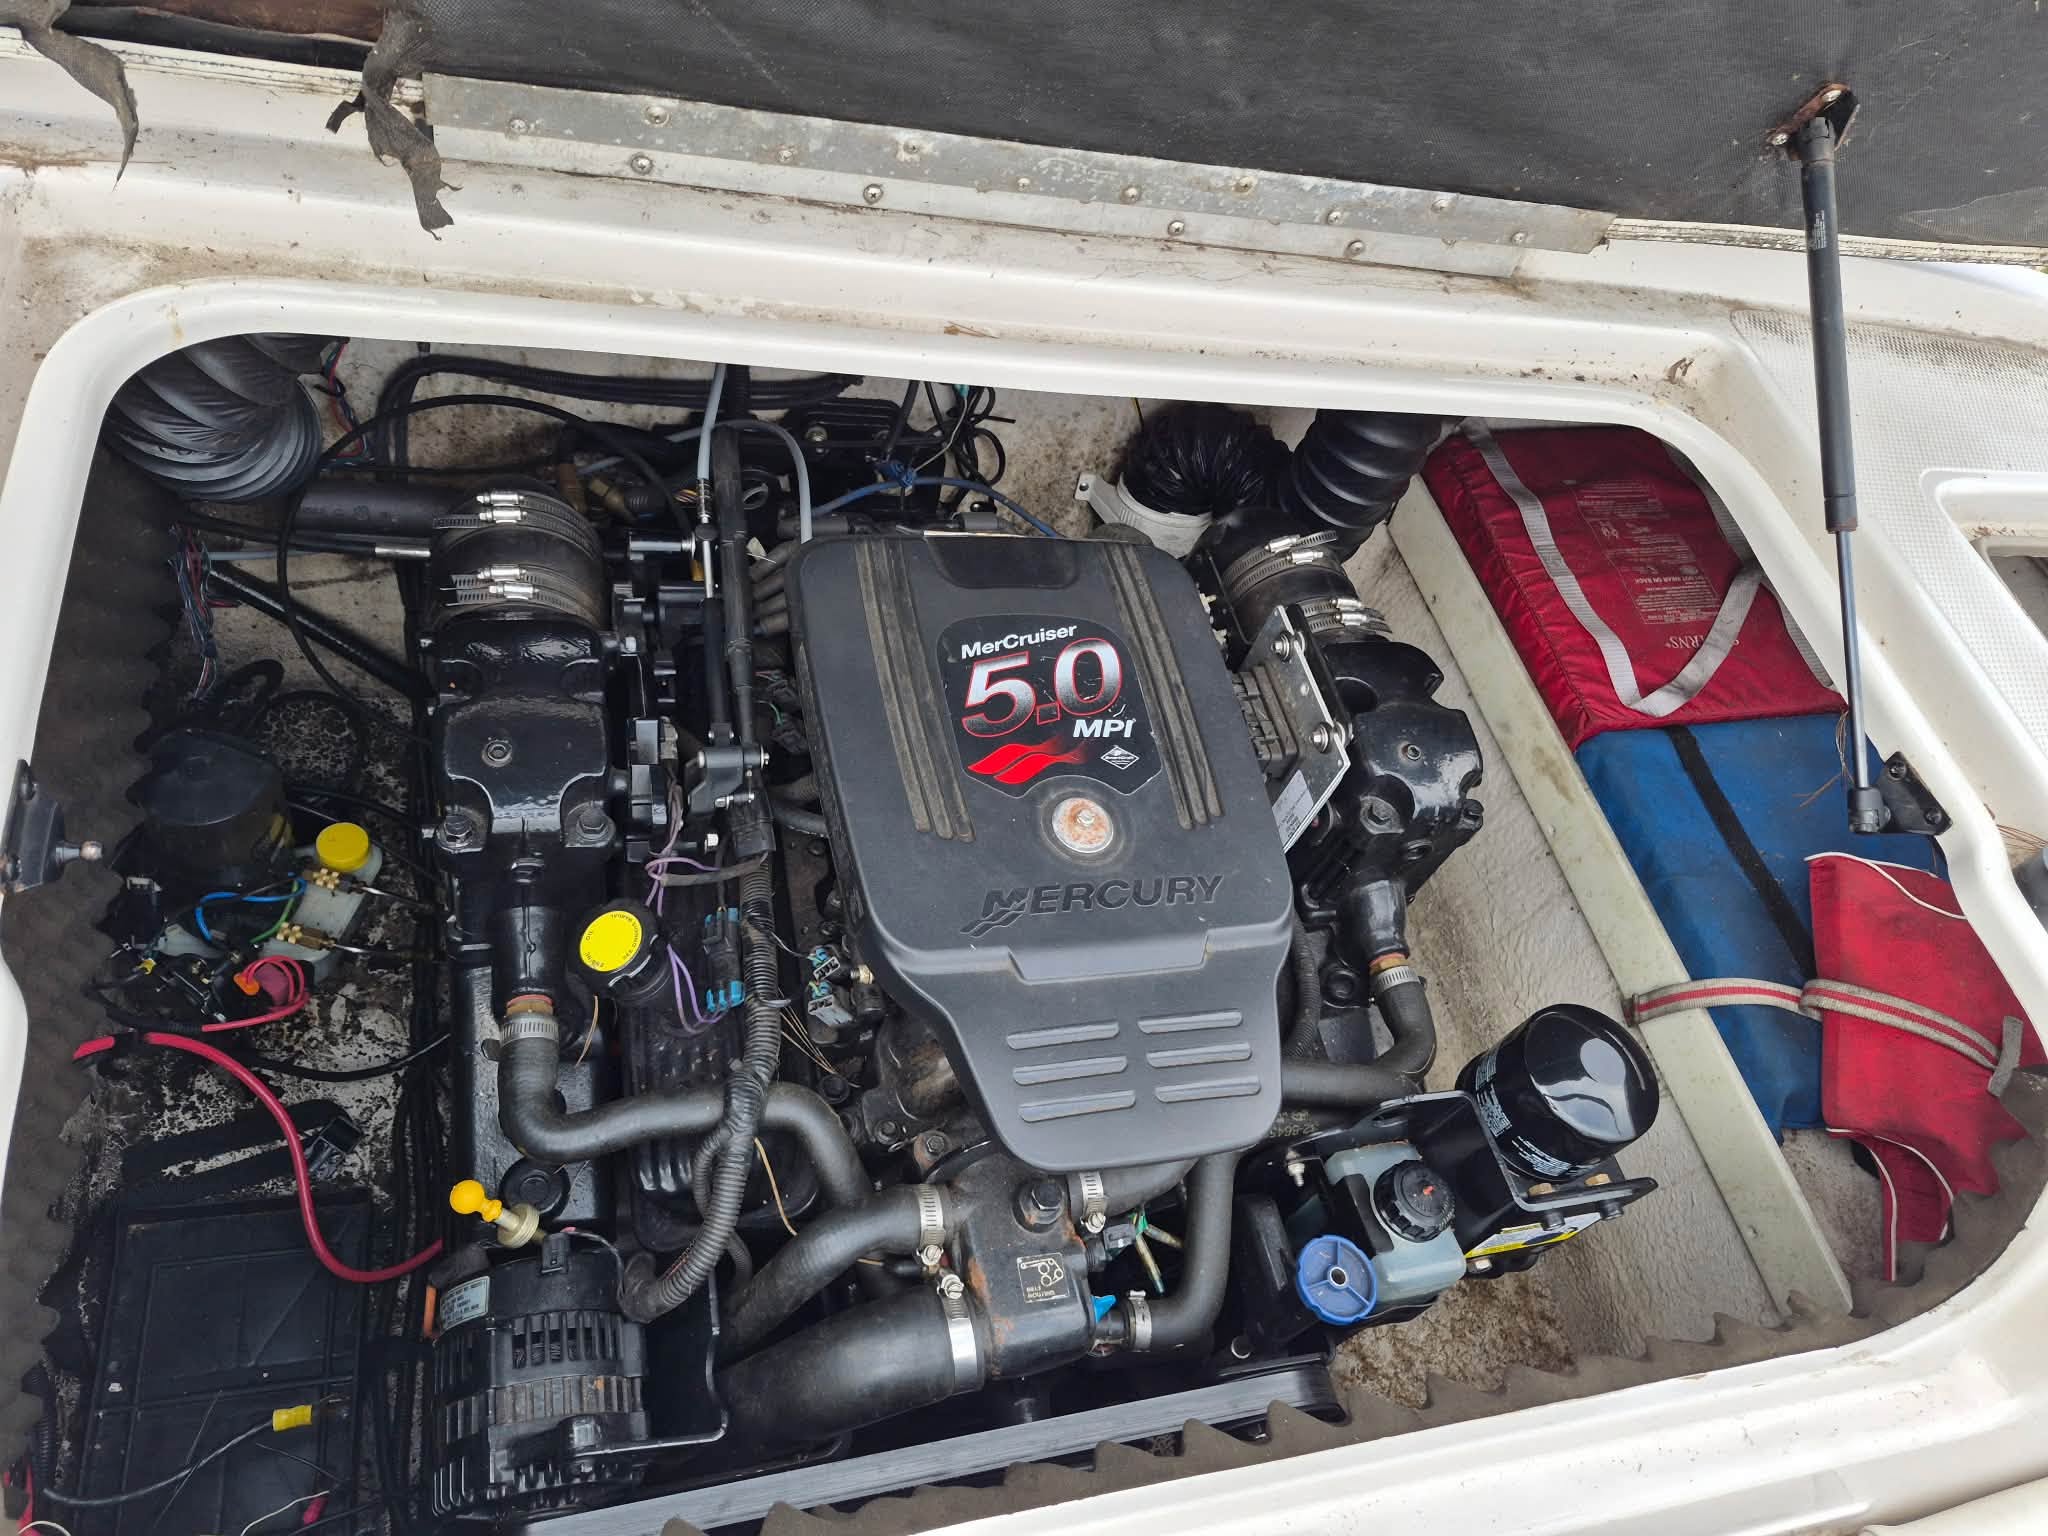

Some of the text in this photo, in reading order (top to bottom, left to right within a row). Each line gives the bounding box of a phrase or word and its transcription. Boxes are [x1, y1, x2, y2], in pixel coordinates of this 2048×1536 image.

[960, 624, 1078, 660] MerCruiser
[961, 637, 1123, 738] 5.0
[1072, 718, 1136, 738] MPI
[964, 875, 1224, 930] MERCURY
